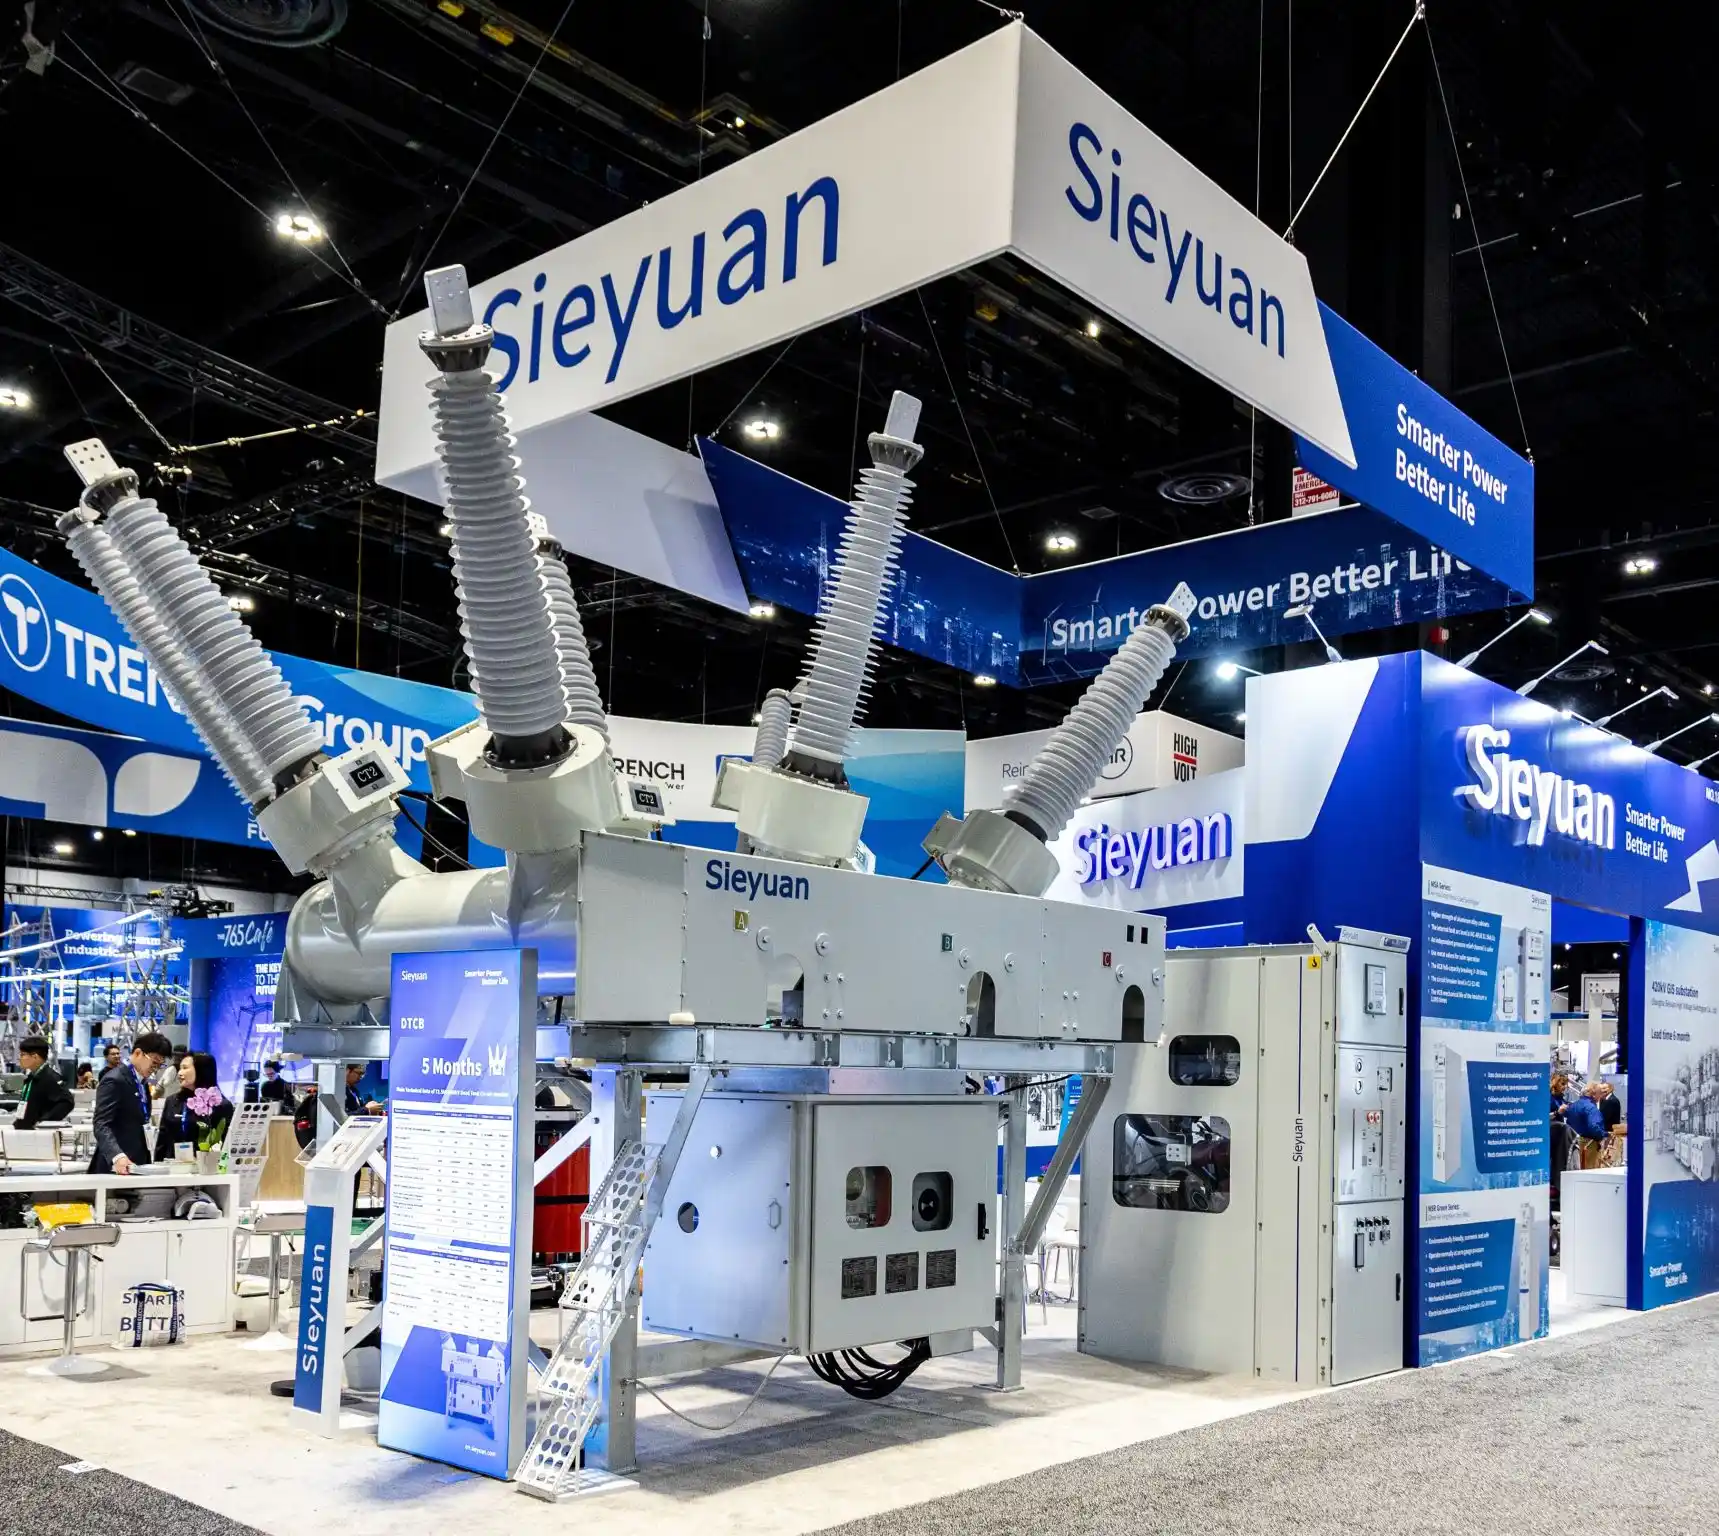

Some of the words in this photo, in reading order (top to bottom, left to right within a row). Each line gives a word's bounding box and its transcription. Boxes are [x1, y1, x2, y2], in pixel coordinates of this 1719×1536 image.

[1065, 122, 1285, 359] Sieyuan
[484, 176, 840, 393] Sieyuan
[1397, 403, 1461, 472] Smarter
[1463, 450, 1508, 504] Power
[1396, 448, 1445, 505] Better
[1448, 483, 1475, 526] Life
[1198, 583, 1280, 620] ower
[1290, 559, 1398, 604] Better
[1410, 545, 1472, 580] Lif
[1173, 732, 1197, 757] HIGH
[357, 766, 378, 782] CT2
[612, 758, 685, 780] RENCH
[639, 792, 654, 804] CT2
[1455, 724, 1615, 849] Sieyuan
[1626, 802, 1659, 832] Smarter
[1660, 816, 1685, 841] Power
[1073, 811, 1232, 889] Sieyuan
[1625, 831, 1651, 857] Better
[1653, 841, 1668, 863] Life
[705, 859, 809, 901] Sieyuan
[737, 913, 745, 928] A
[224, 924, 244, 947] 765
[245, 920, 274, 952] Café
[944, 937, 950, 949] B
[255, 974, 266, 985] TO
[401, 970, 427, 982] Sieyuan
[1667, 983, 1675, 996] GIS
[1675, 984, 1699, 998] substation
[400, 1017, 425, 1030] DTCB
[1651, 1028, 1662, 1039] Lead
[1662, 1030, 1673, 1040] time
[422, 1057, 430, 1074] 5
[433, 1058, 482, 1076] Months
[1293, 1118, 1305, 1162] Sieyuan
[122, 1290, 184, 1306] SARTR
[303, 1244, 325, 1375] Sieyuan
[120, 1314, 184, 1331] BTTR
